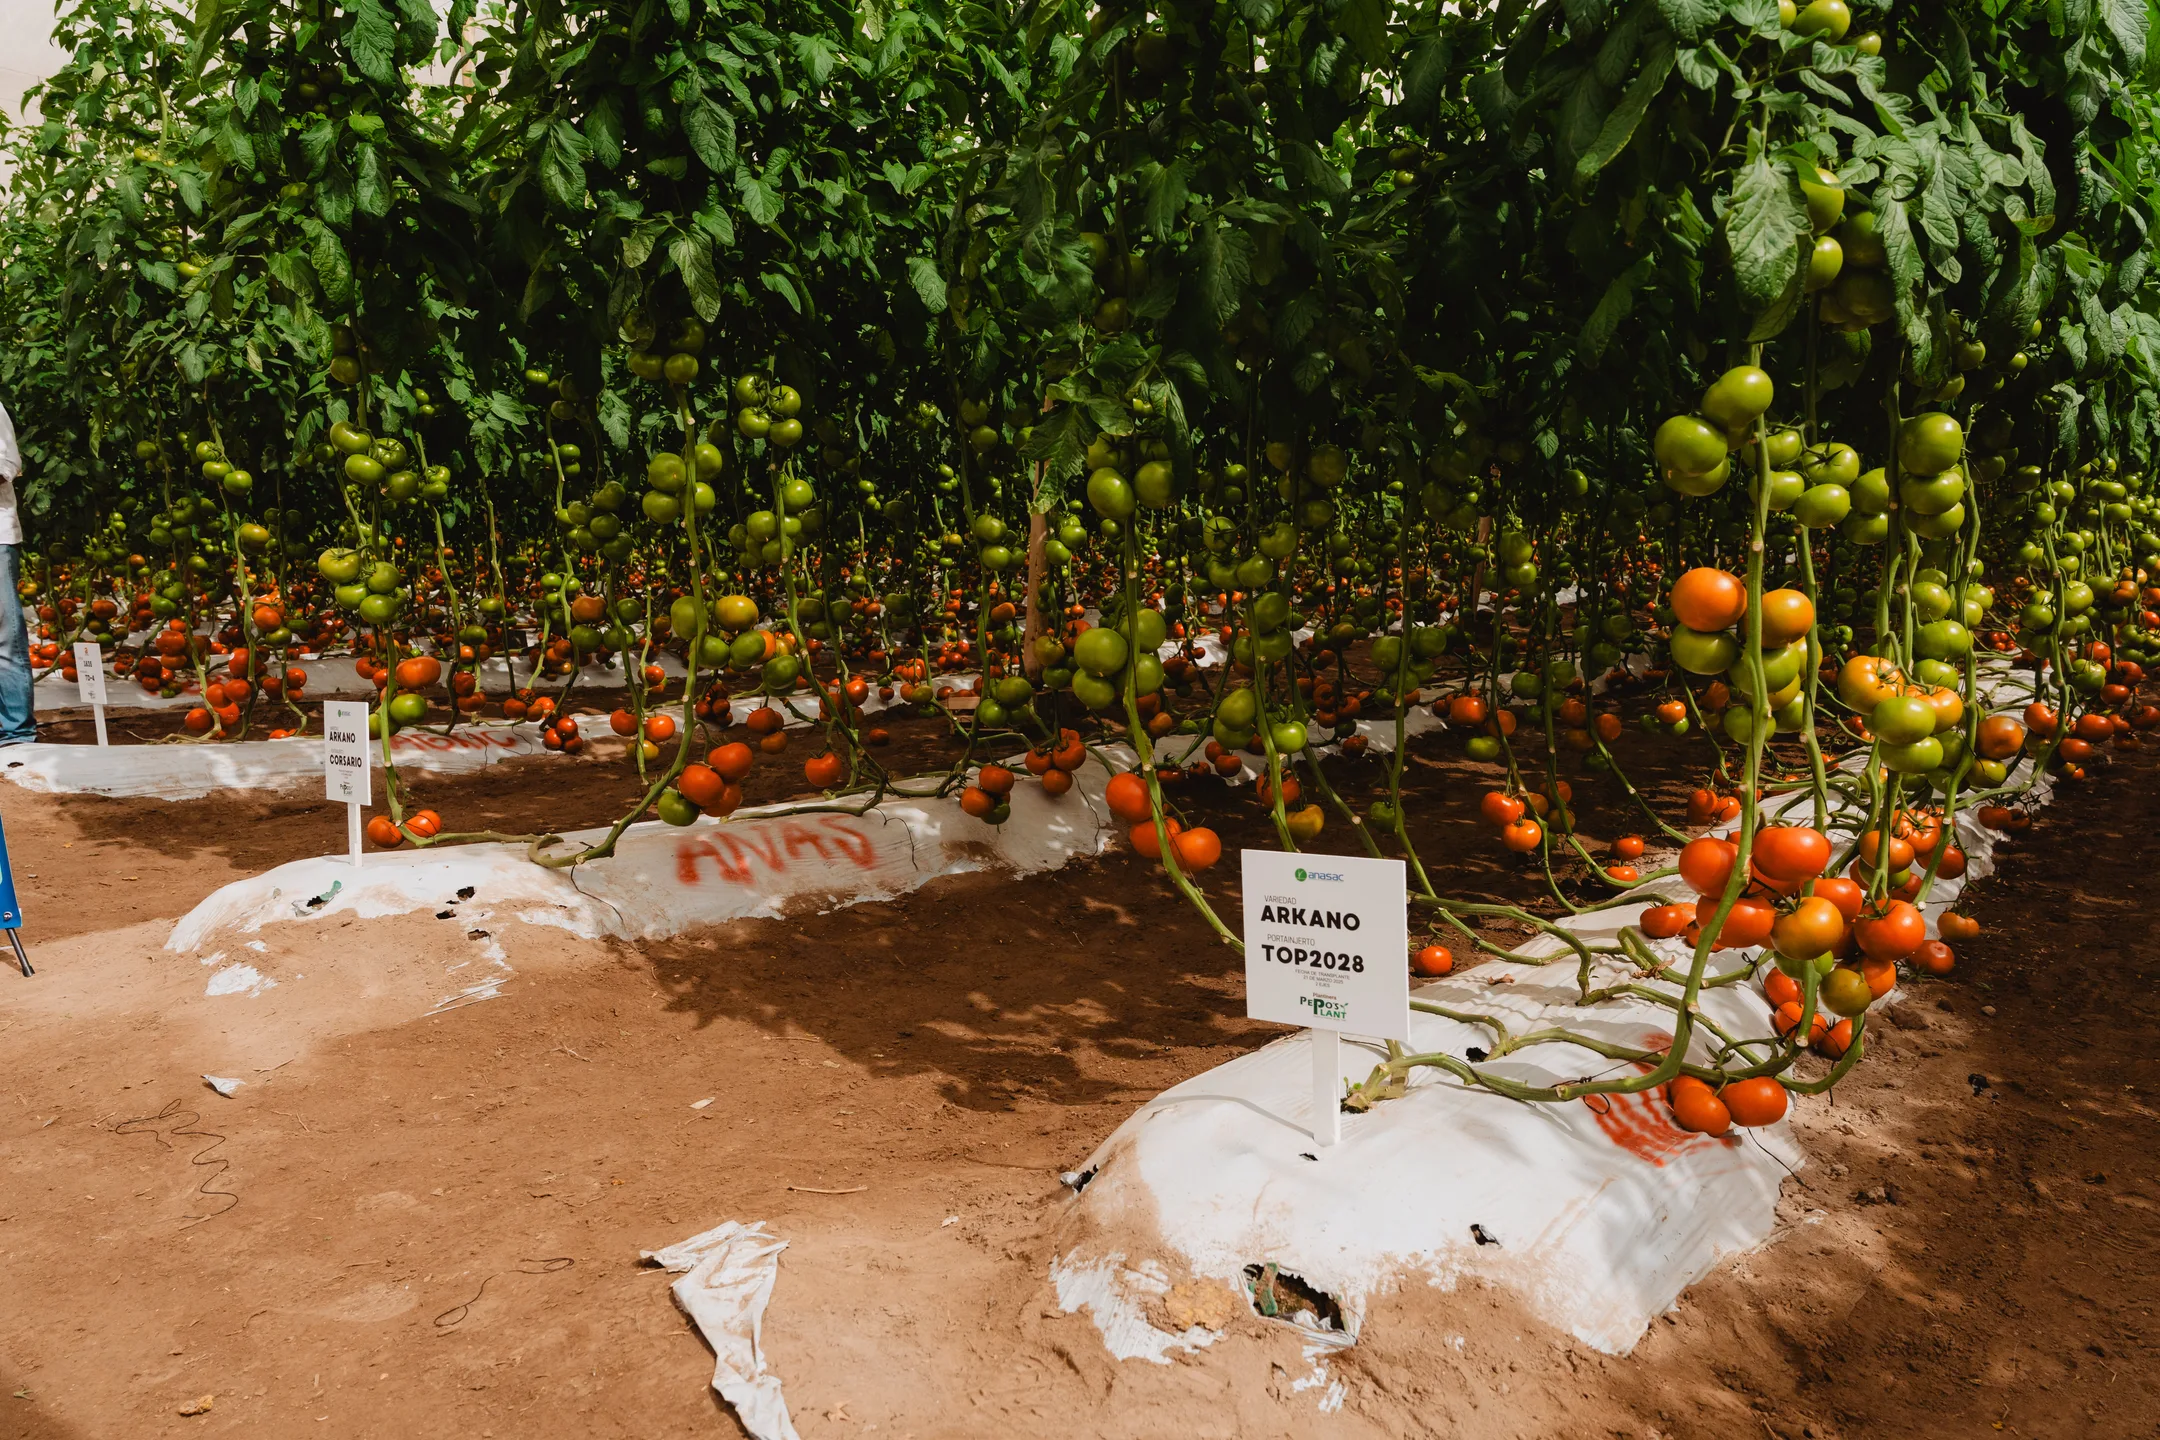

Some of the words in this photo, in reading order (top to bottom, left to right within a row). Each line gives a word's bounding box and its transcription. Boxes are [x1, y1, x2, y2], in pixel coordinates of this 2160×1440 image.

[329, 731, 356, 743] ARKANO
[329, 754, 362, 768] CORSARIO
[1308, 870, 1344, 882] anasac
[1264, 895, 1297, 905] VARIEDAD
[1260, 905, 1361, 931] ARKANO
[1267, 934, 1315, 946] PORTAINJERTO
[1261, 944, 1365, 973] TOP2028
[1318, 972, 1350, 980] TRANSPLANTE
